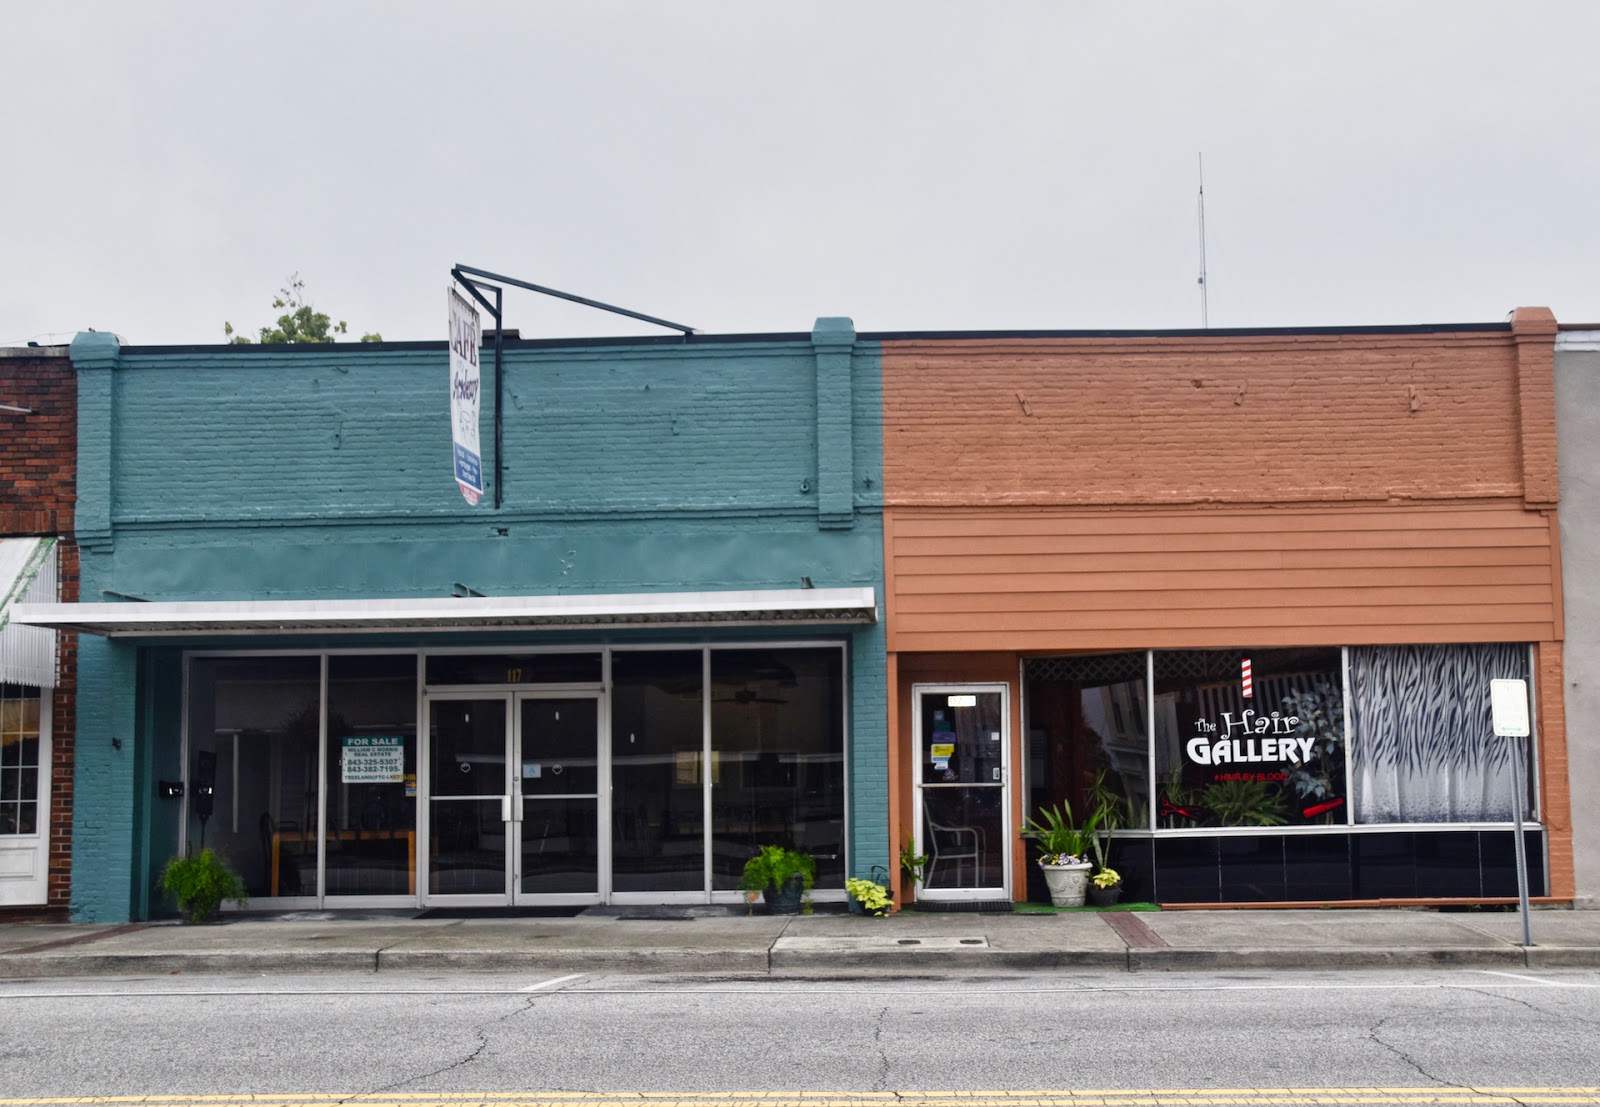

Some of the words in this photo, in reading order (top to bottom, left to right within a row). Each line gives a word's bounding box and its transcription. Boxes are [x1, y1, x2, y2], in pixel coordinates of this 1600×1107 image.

[507, 668, 522, 682] 117
[1195, 718, 1217, 732] The
[1220, 709, 1299, 740] Hair
[347, 738, 369, 746] FOR
[371, 738, 398, 746] SALE
[1187, 737, 1315, 765] GALLERY
